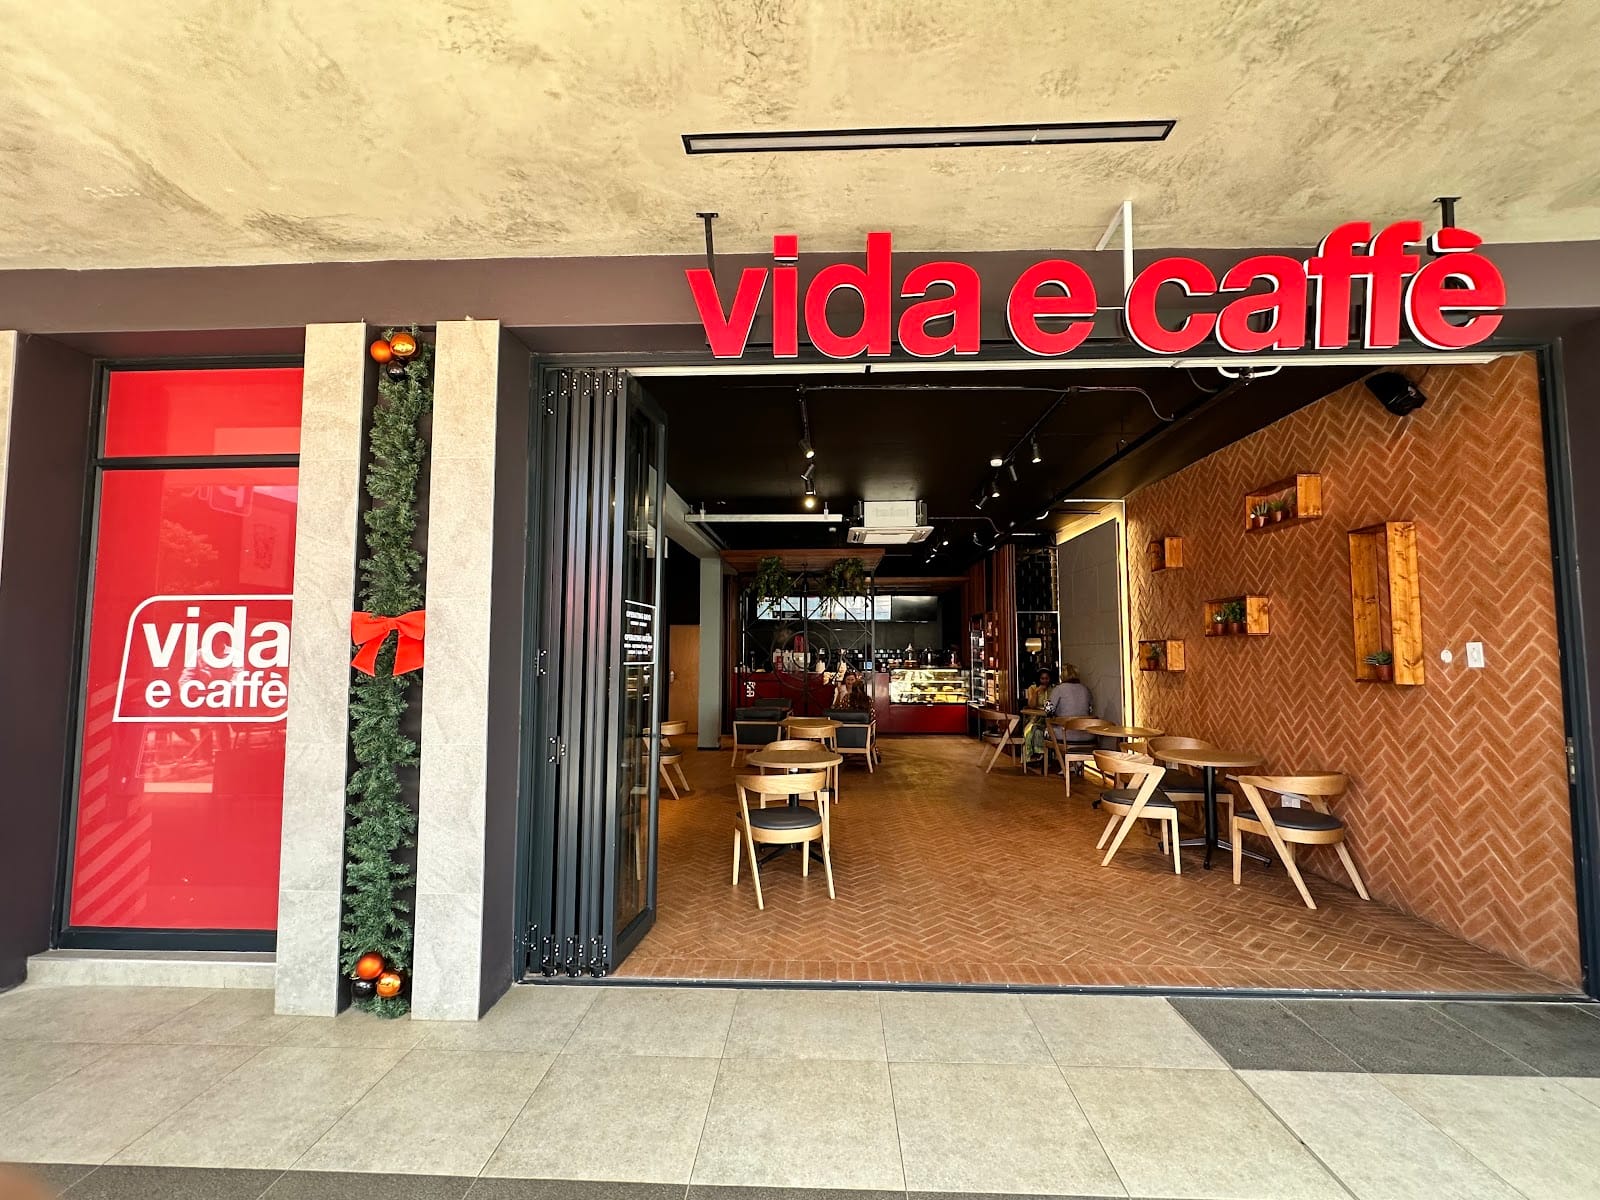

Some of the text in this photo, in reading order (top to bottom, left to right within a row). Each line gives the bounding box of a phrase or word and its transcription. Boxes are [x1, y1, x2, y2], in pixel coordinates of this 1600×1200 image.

[685, 220, 1506, 358] vida e caffè
[142, 606, 290, 669] vida
[145, 671, 287, 708] e caffè
